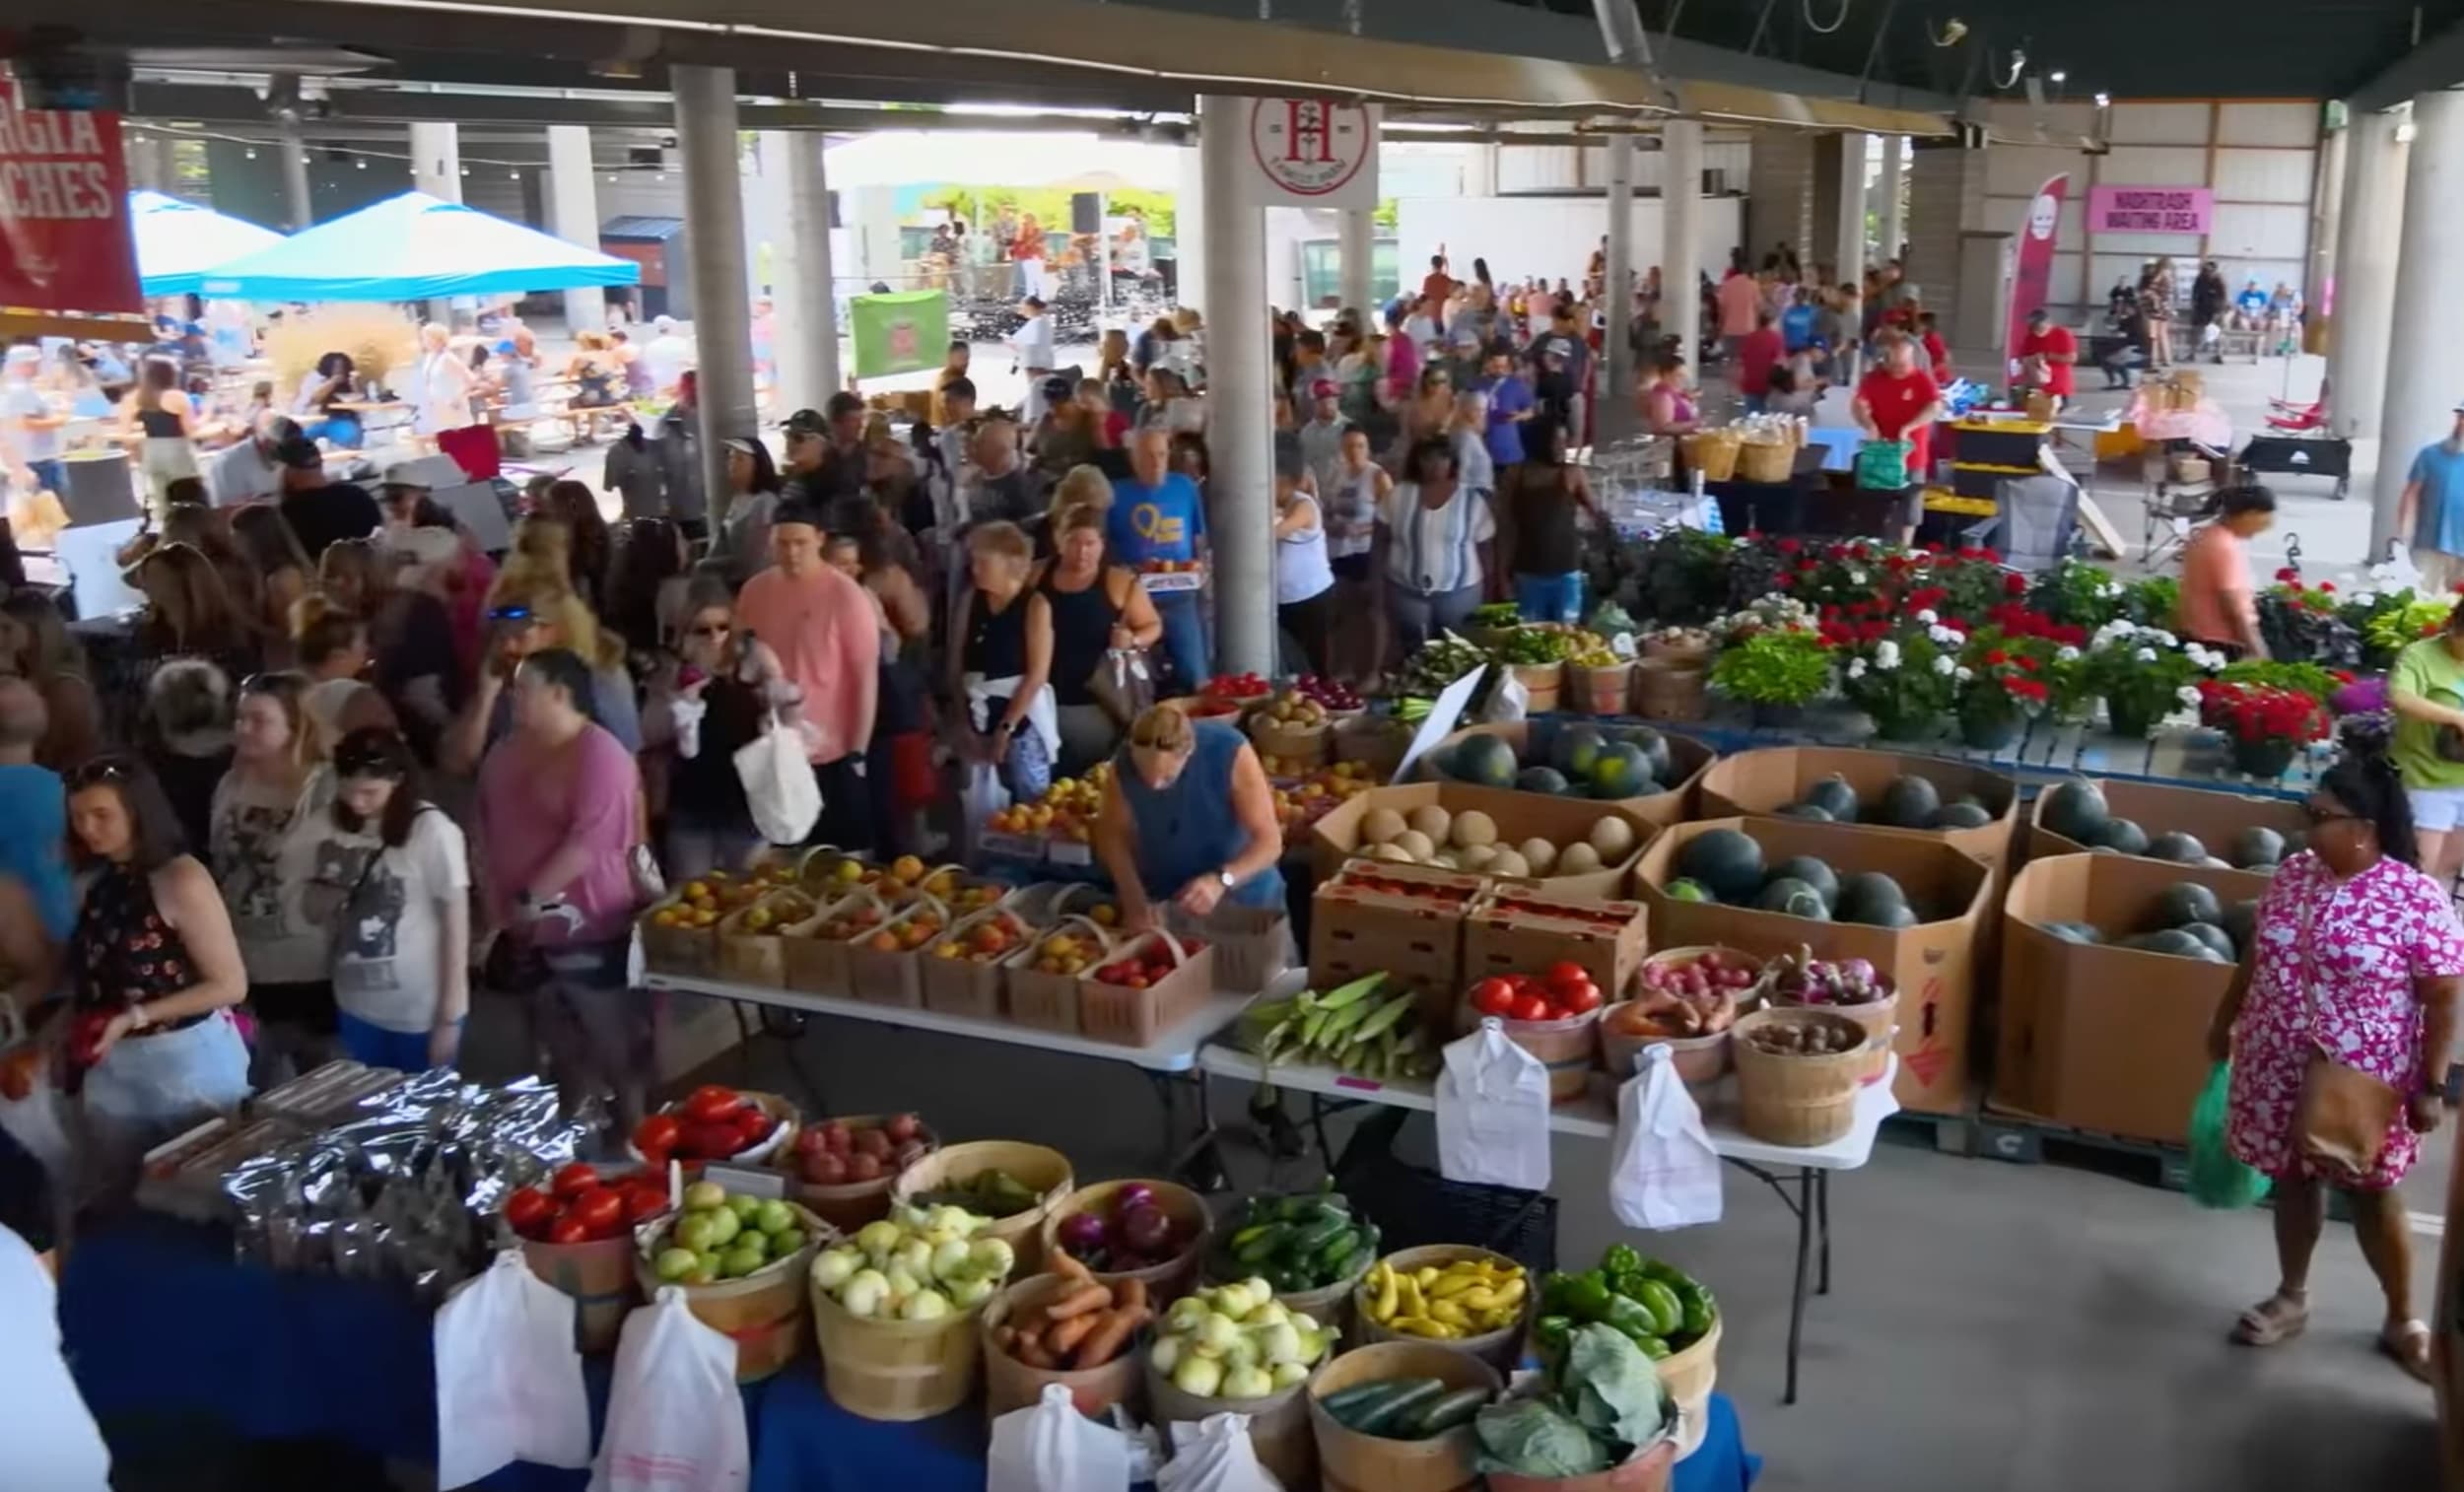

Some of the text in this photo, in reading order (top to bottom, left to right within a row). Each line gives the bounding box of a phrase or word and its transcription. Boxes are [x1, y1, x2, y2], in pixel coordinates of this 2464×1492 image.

[1284, 100, 1335, 162] H
[2105, 212, 2199, 230] WAITING AREA
